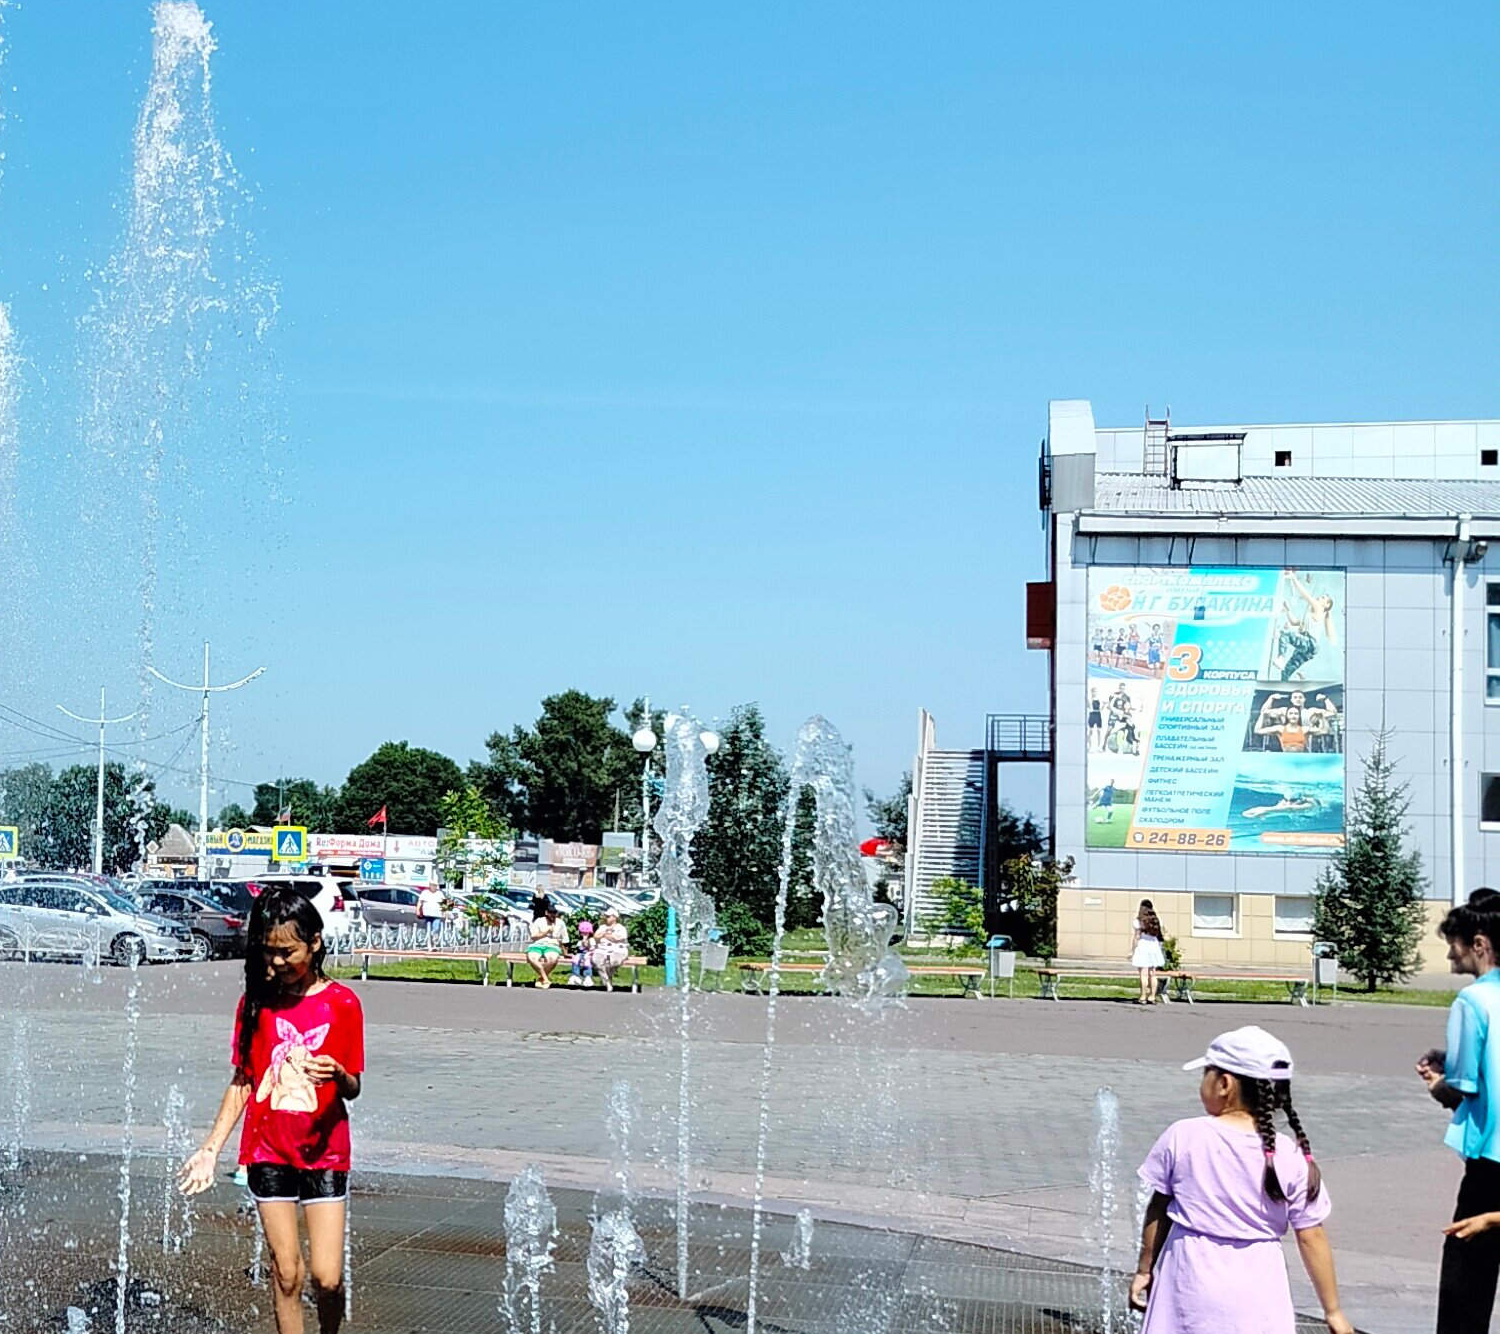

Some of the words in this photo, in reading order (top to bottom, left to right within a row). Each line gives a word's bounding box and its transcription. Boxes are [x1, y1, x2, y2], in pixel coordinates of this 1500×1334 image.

[1122, 575, 1251, 587] СПОРТКОМПЛЕКС
[1167, 644, 1201, 681] 3
[1203, 670, 1255, 680] КОРПУСА
[1165, 682, 1253, 697] ЗДОРОВЬЯ
[1161, 700, 1176, 714] И
[1179, 700, 1247, 714] СПОРТА
[248, 835, 273, 845] МАГАЗИ
[359, 838, 381, 849] Дома
[1148, 832, 1226, 846] 24-88-26
